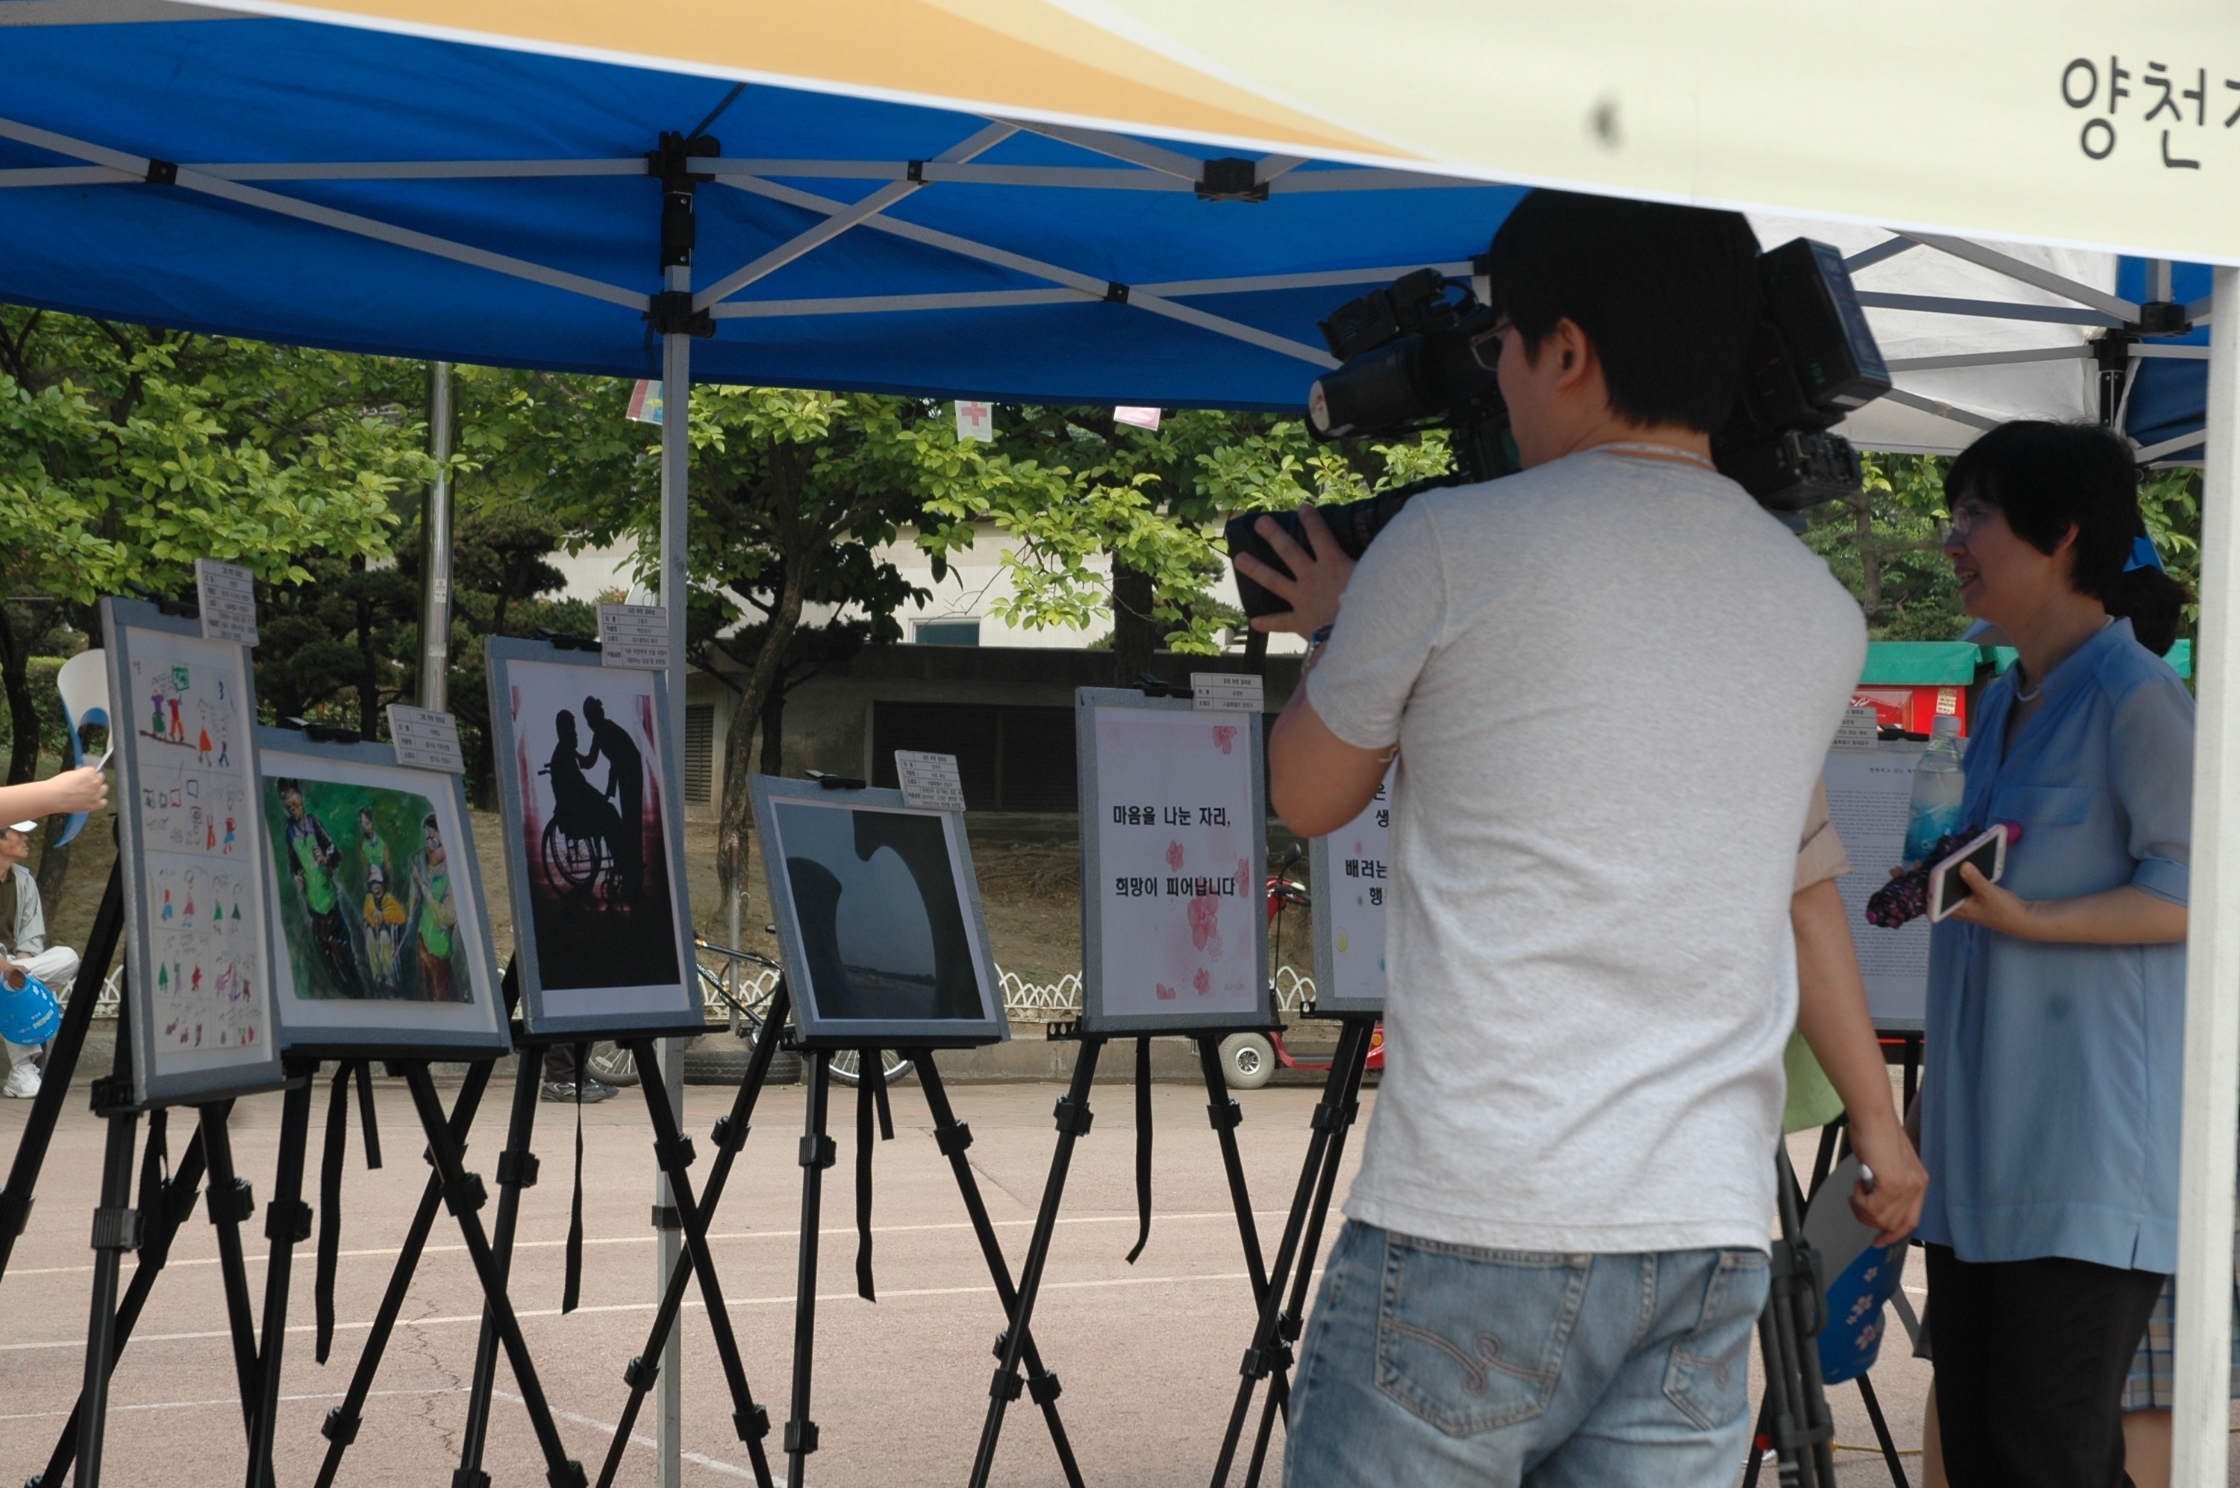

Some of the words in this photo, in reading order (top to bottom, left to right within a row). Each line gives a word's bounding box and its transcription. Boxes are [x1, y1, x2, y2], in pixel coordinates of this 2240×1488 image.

[1113, 805, 1156, 826] 마음을
[1164, 806, 1191, 826] 나눈
[1199, 807, 1231, 828] 자리,
[1345, 859, 1388, 879] 배려는
[1115, 877, 1158, 897] 희망이
[1166, 877, 1235, 897] 피어납니다
[1369, 886, 1387, 906] 행
